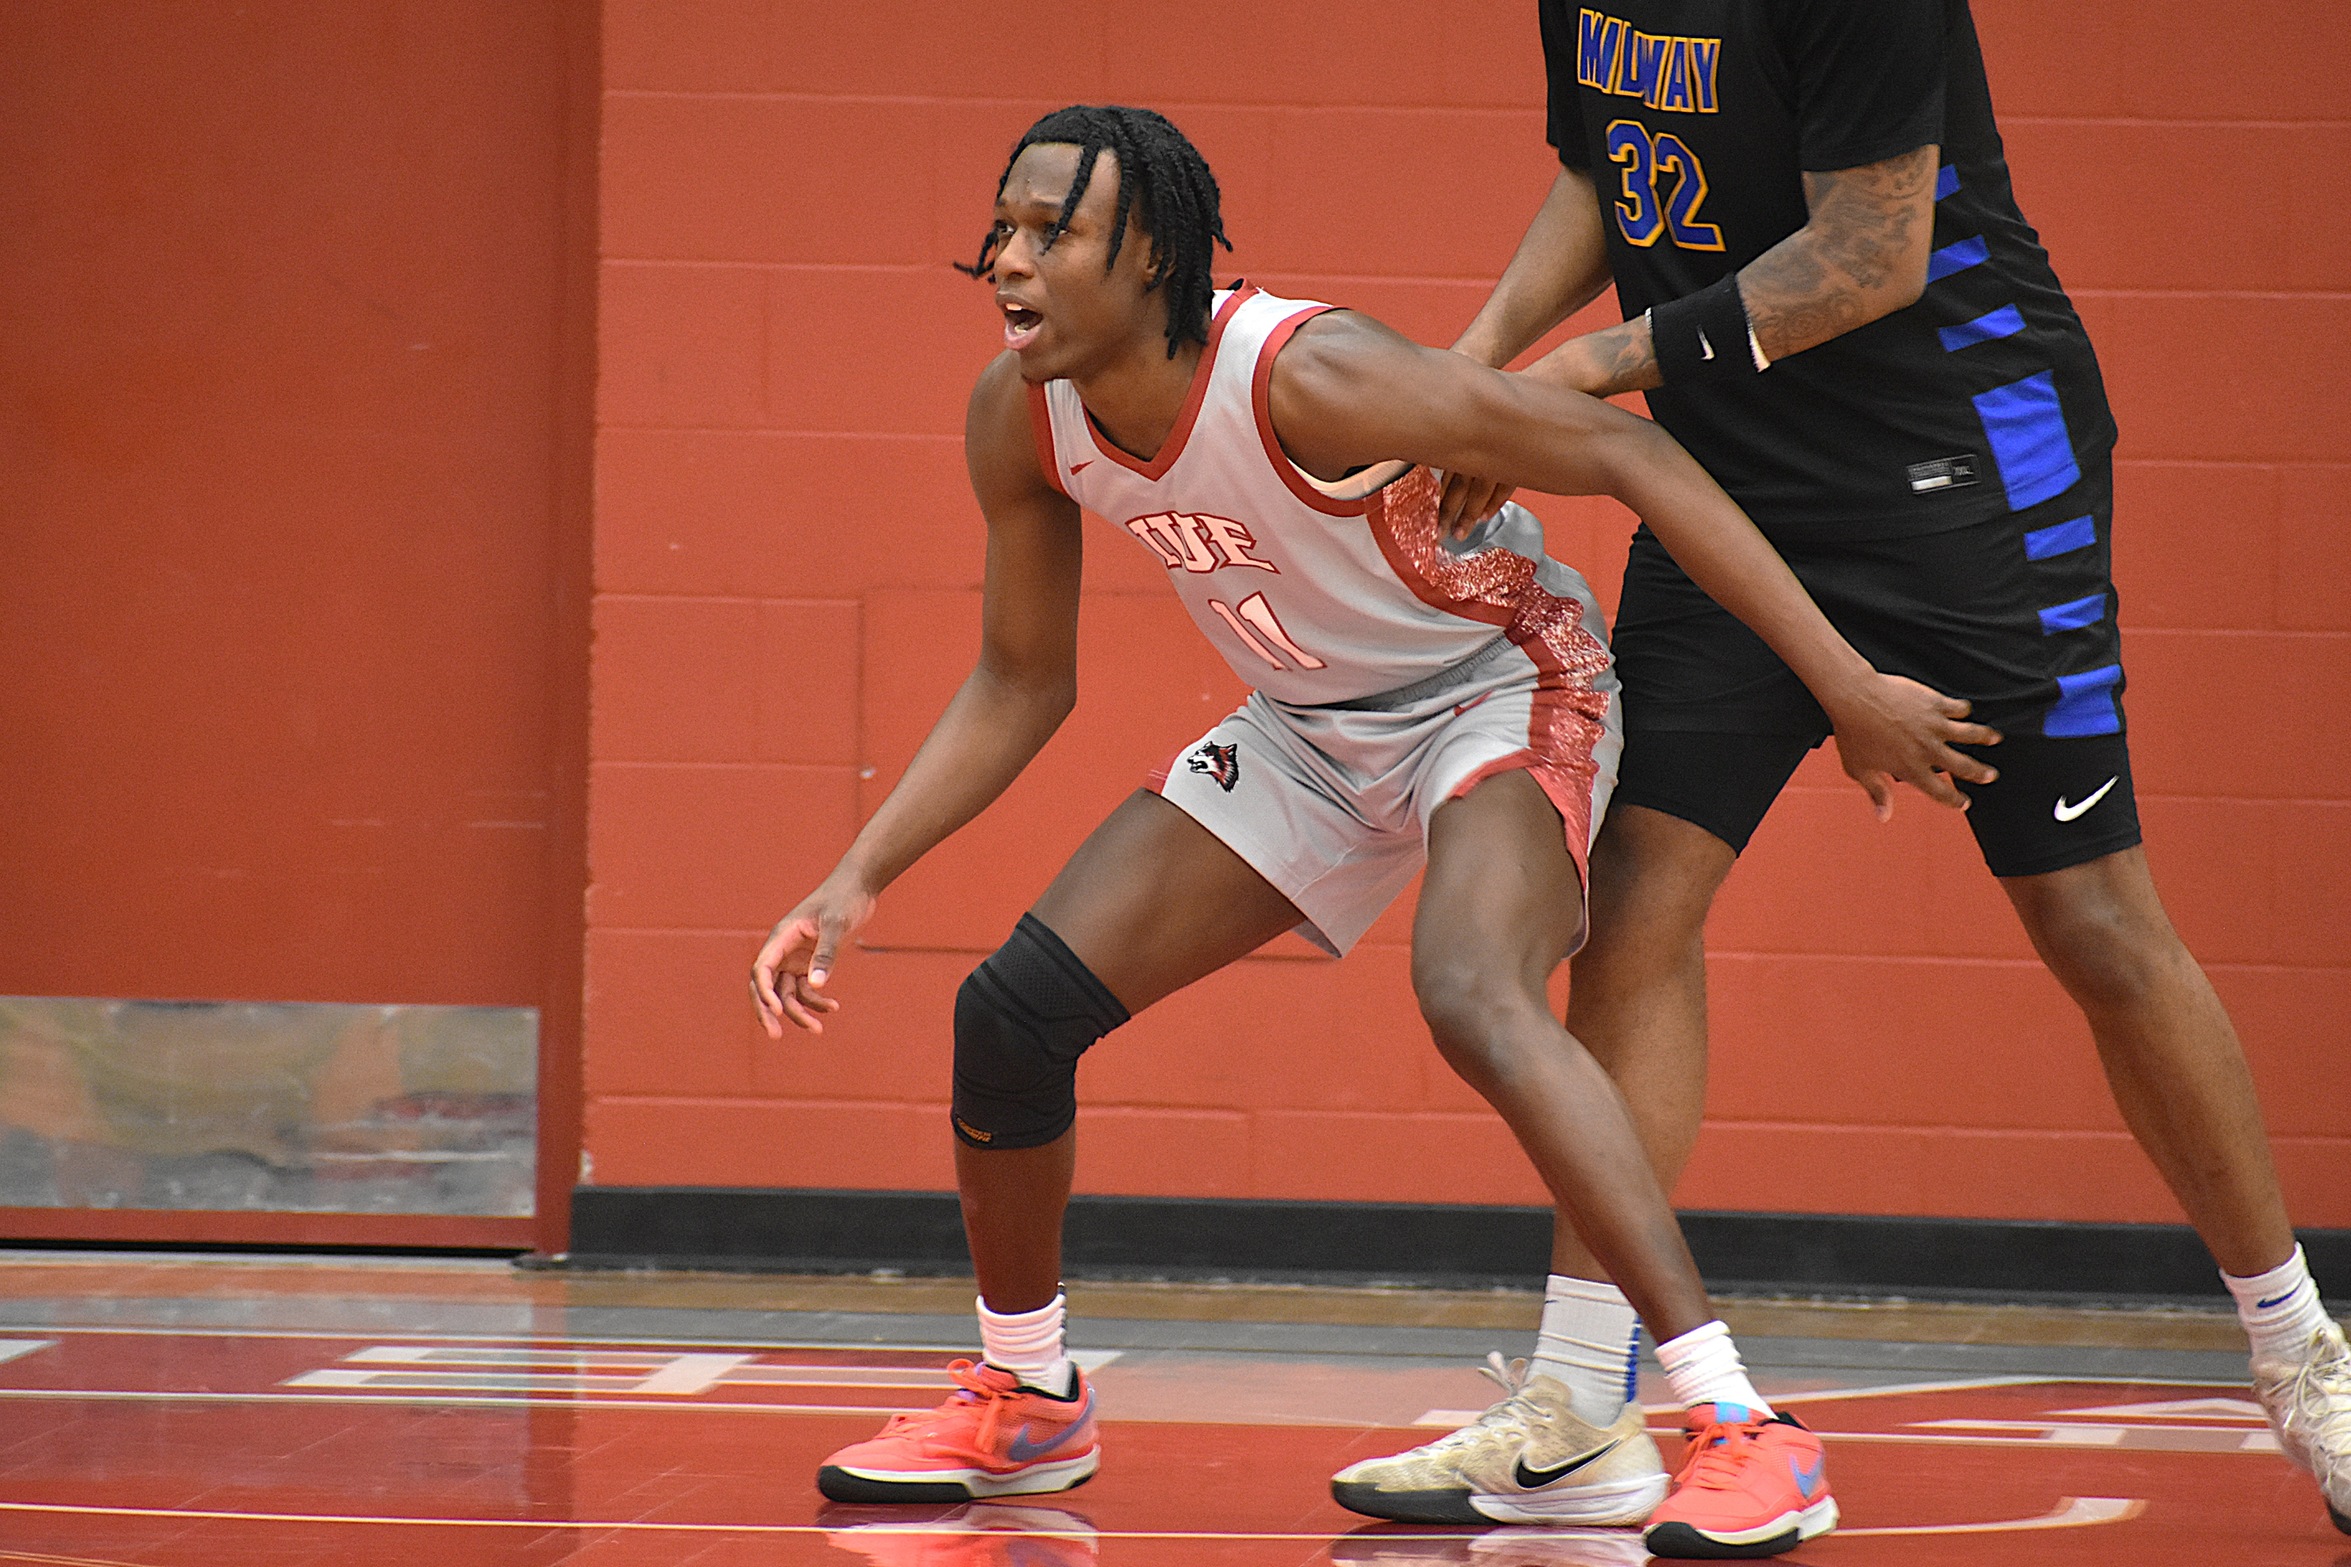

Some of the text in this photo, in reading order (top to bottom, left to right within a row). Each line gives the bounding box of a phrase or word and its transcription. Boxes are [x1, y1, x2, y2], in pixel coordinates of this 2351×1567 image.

[1605, 119, 1727, 252] 32
[1125, 510, 1281, 575] IUE
[1207, 590, 1327, 671] 11
